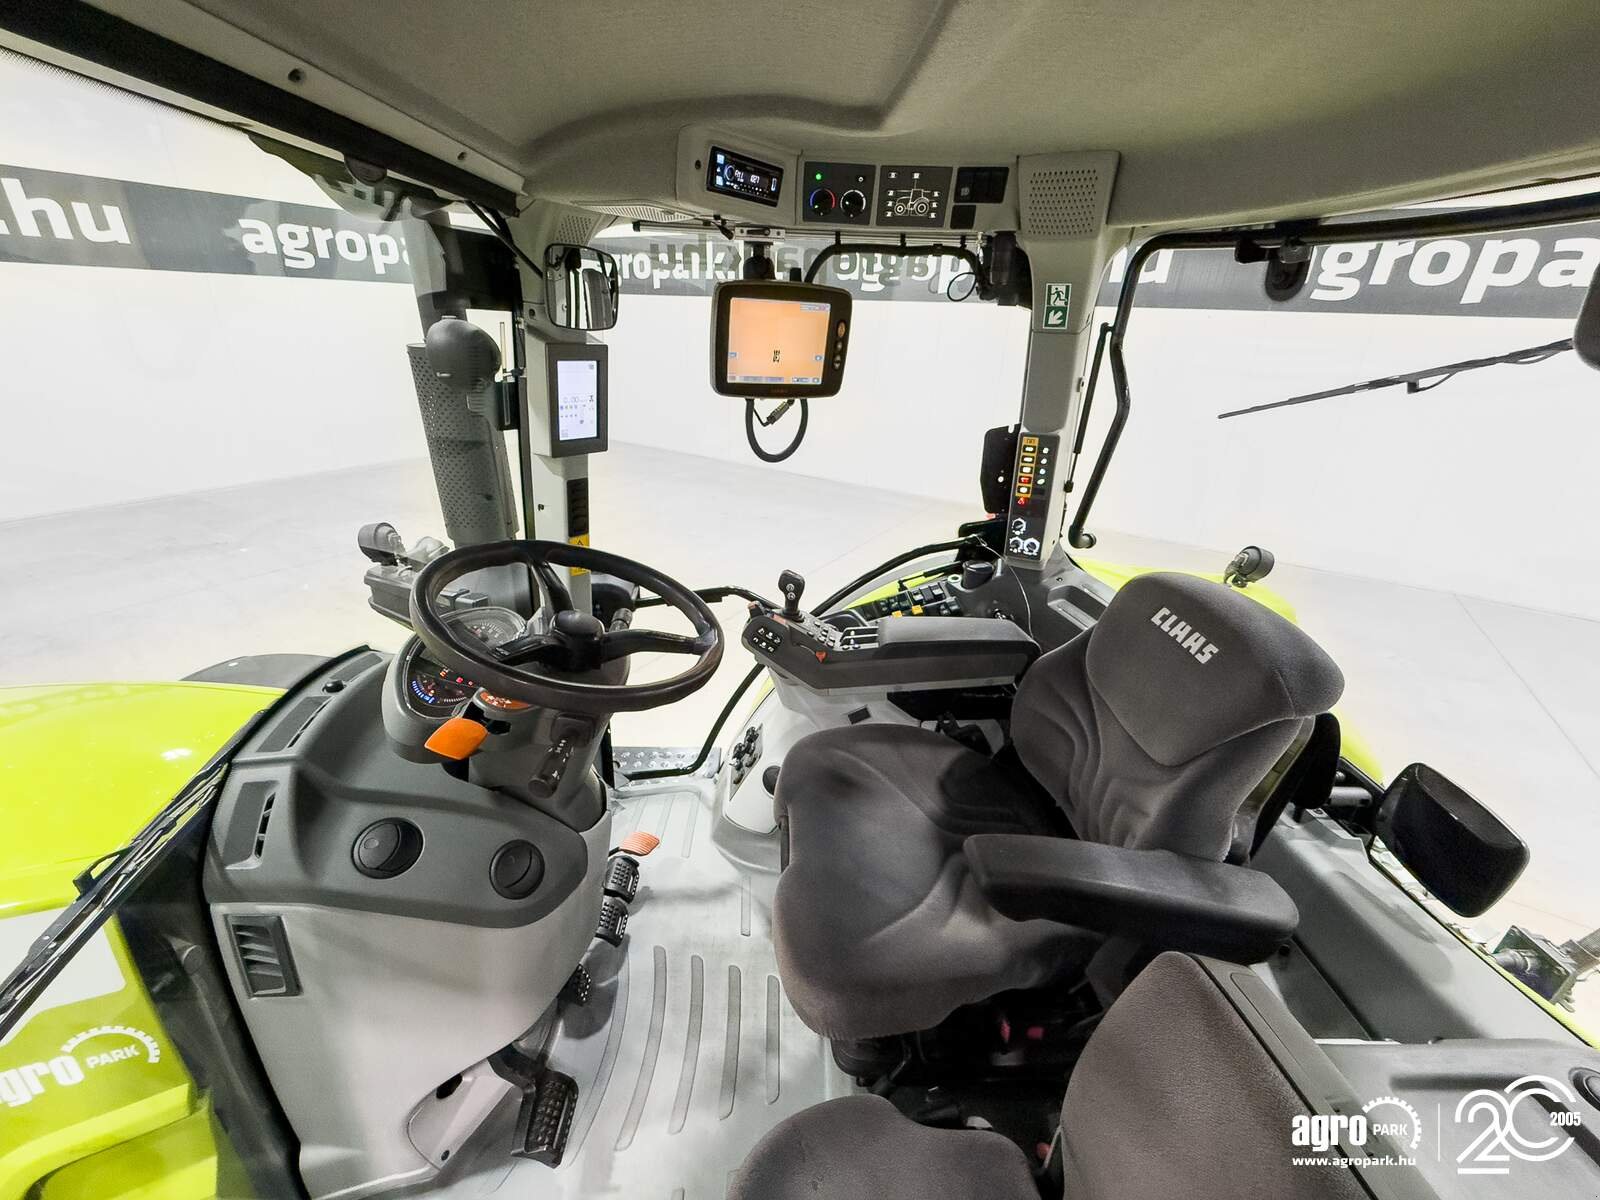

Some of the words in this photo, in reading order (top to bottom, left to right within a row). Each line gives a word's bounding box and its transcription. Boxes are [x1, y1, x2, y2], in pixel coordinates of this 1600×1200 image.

[1304, 237, 1600, 305] gropa
[1151, 607, 1219, 664] CLAAS
[0, 1055, 85, 1108] gro
[86, 1044, 141, 1069] PARK
